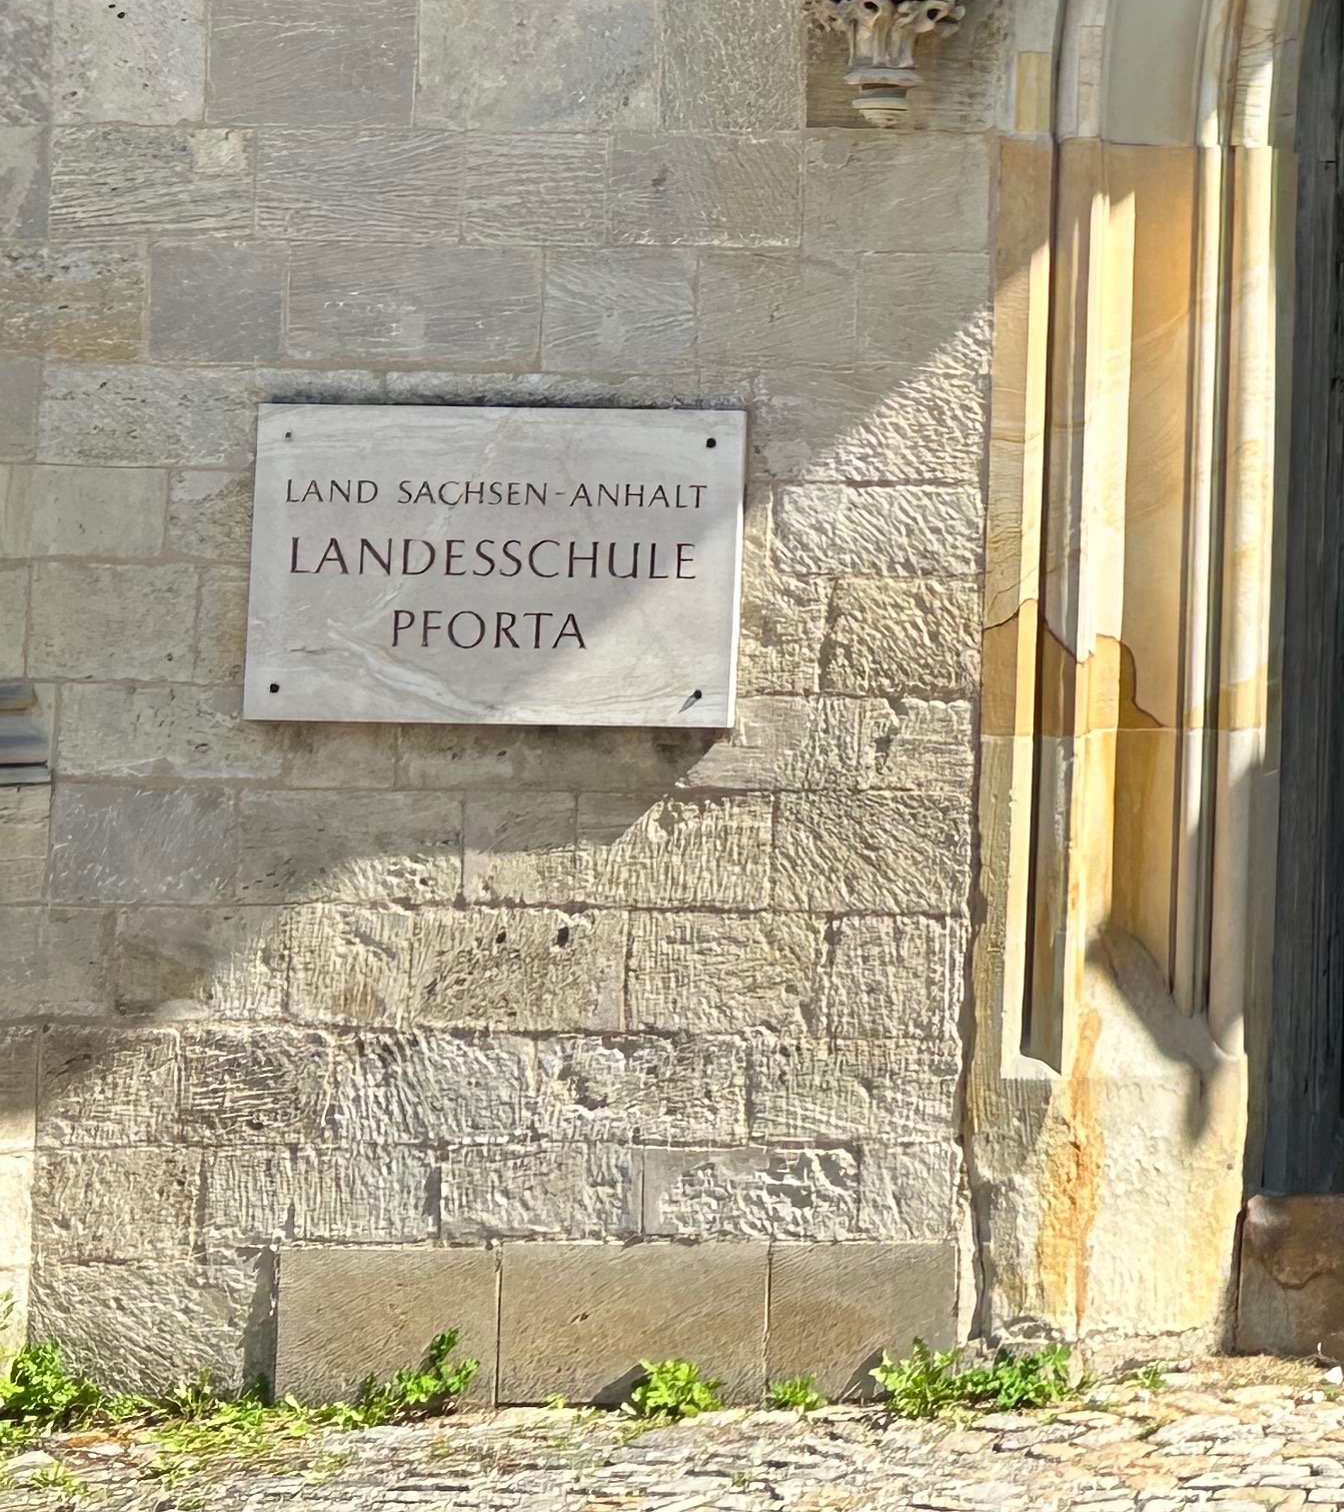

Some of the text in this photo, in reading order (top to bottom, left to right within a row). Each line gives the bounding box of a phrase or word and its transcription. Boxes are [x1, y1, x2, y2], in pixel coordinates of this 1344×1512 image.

[285, 479, 708, 509] LAND SACHSEN-ANHALT
[289, 536, 697, 581] LANDESSCHULE
[391, 609, 587, 650] PFORTA
